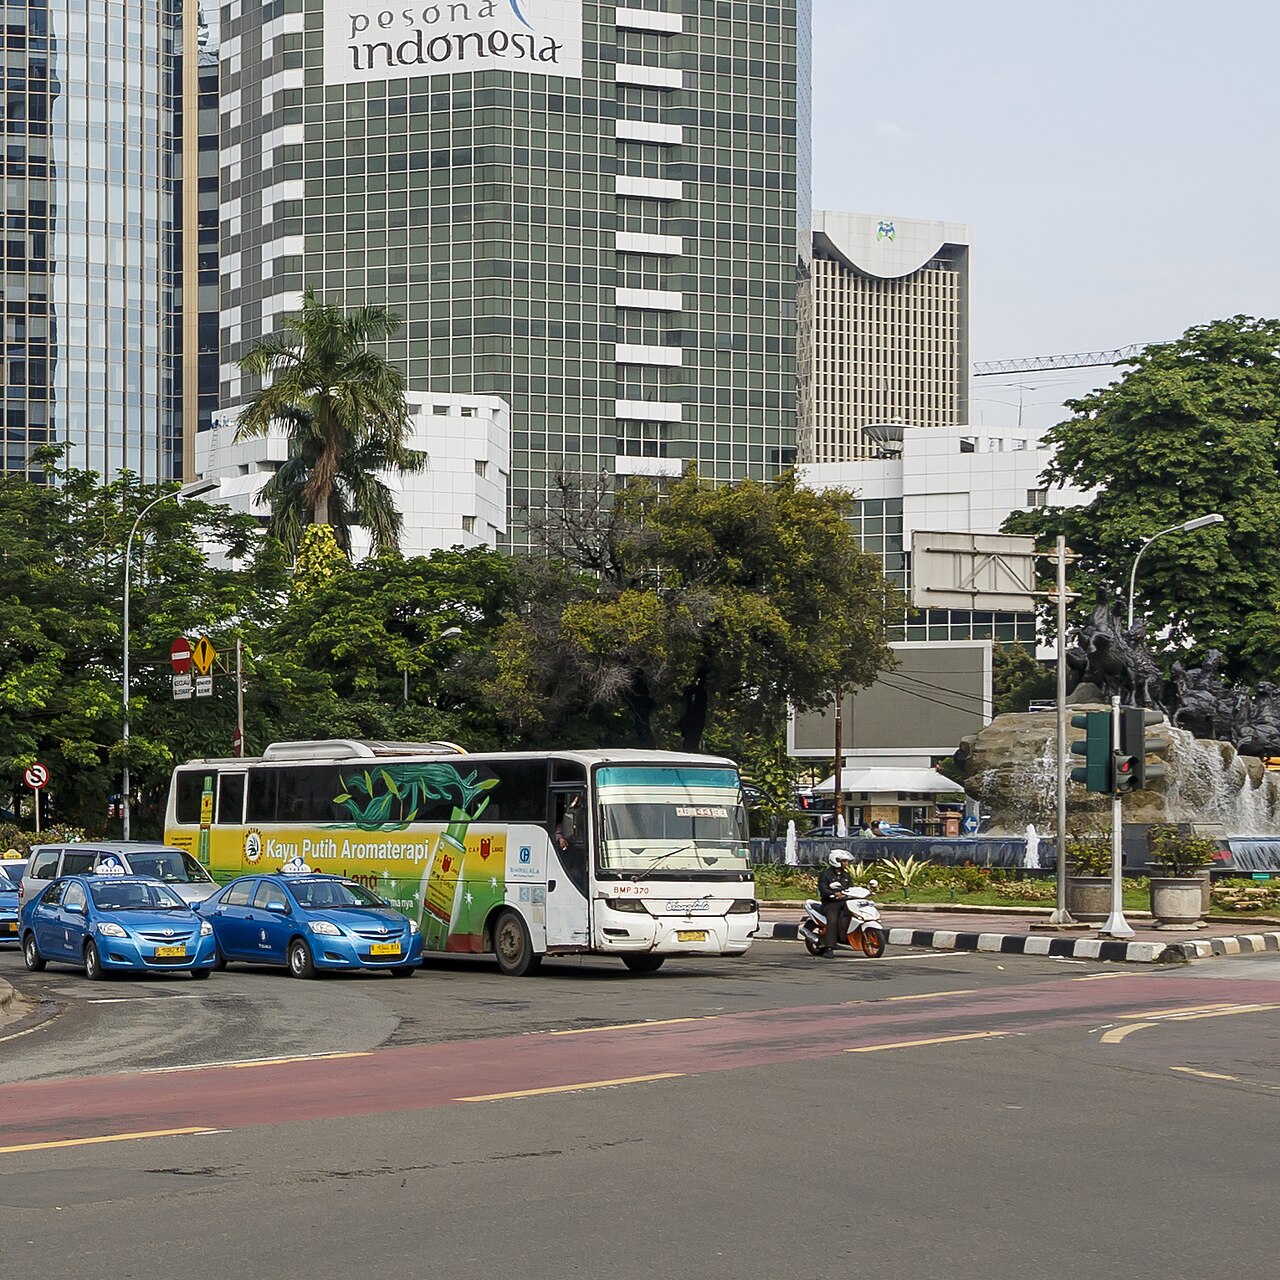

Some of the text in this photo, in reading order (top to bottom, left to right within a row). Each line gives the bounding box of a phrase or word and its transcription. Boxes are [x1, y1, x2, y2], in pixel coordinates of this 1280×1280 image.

[348, 0, 499, 40] pesona
[348, 29, 564, 70] indonesia
[266, 839, 299, 863] Kayu
[302, 838, 338, 860] Putih
[340, 838, 430, 865] Aromaterapi
[613, 886, 650, 895] BMP 370
